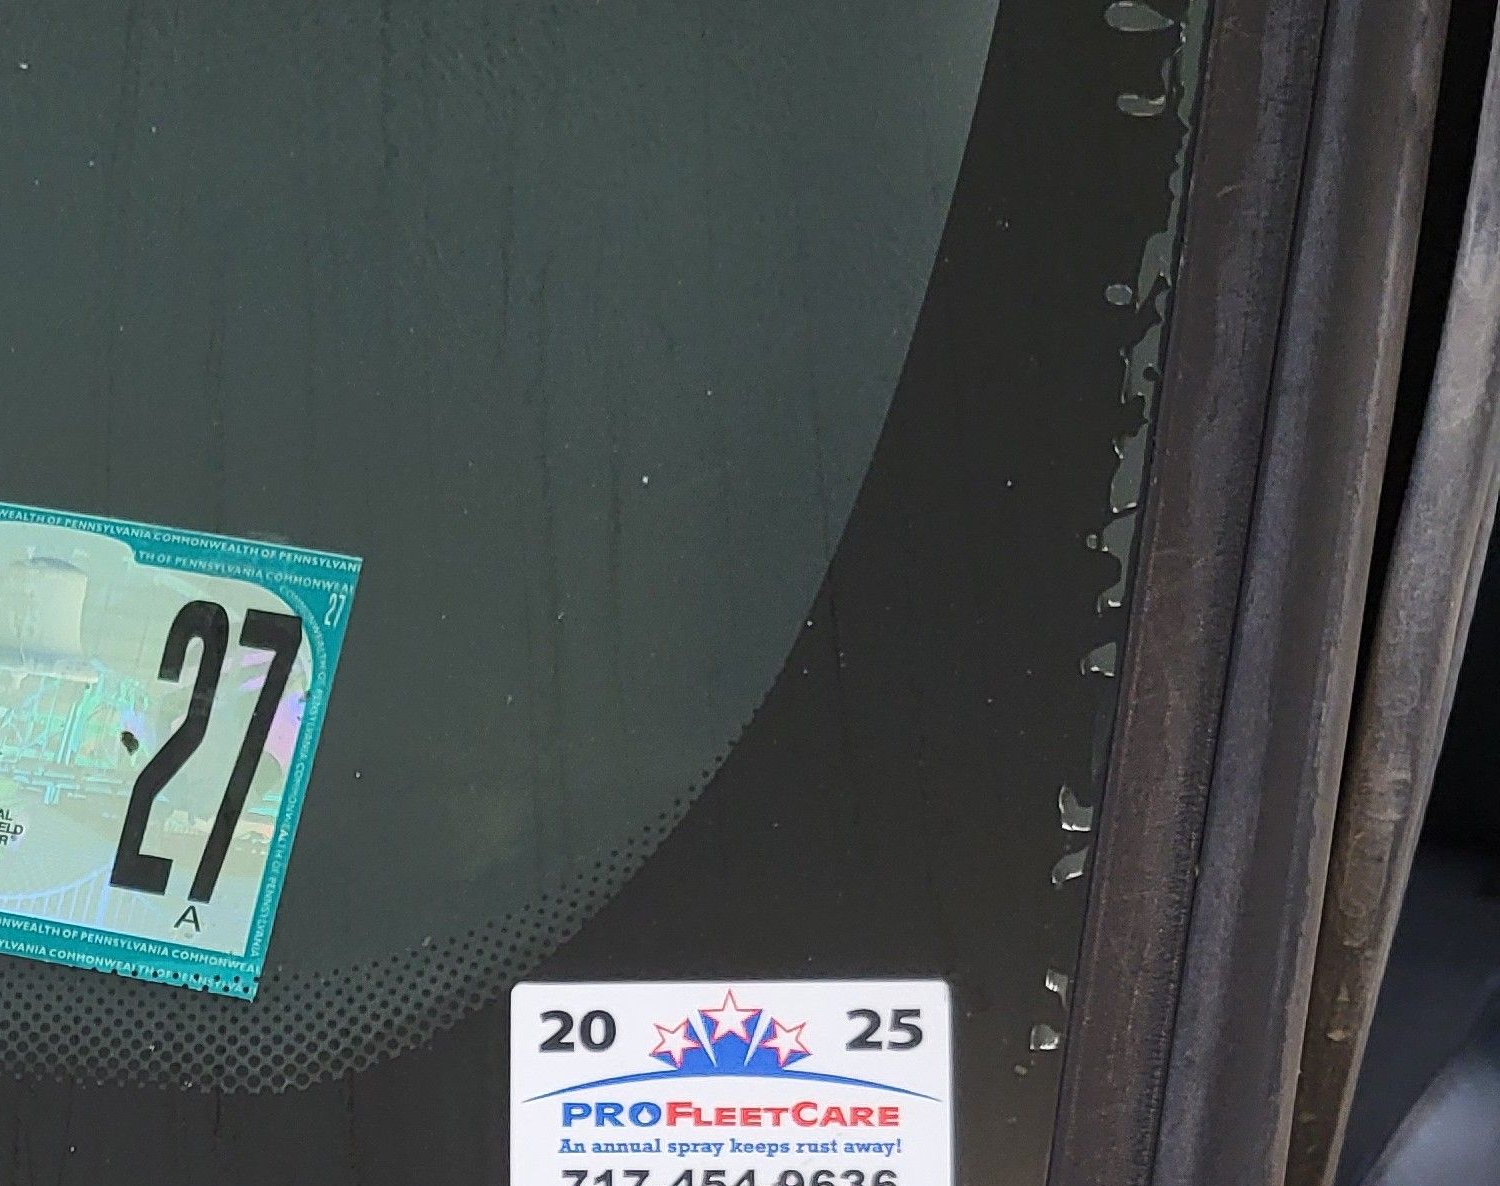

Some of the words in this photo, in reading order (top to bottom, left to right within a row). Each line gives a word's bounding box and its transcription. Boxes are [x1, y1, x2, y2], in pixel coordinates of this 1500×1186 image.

[47, 515, 63, 526] OF
[65, 517, 151, 539] PENNSYLVANIA
[153, 530, 259, 555] COMMONWEALTH
[260, 548, 277, 559] OF
[175, 556, 263, 581] PENNSYLVANIA
[325, 593, 347, 627] 27
[109, 600, 302, 904] 27
[173, 905, 201, 933] A
[62, 928, 79, 939] OF
[80, 931, 169, 957] PENNSYLVANIA
[539, 1009, 617, 1053] 20
[845, 1008, 924, 1052] 25
[558, 1139, 587, 1154] An
[591, 1138, 662, 1154] annual
[667, 1140, 724, 1158] spray
[729, 1138, 791, 1157] keeps
[796, 1139, 839, 1154] rust
[843, 1138, 903, 1158] away!
